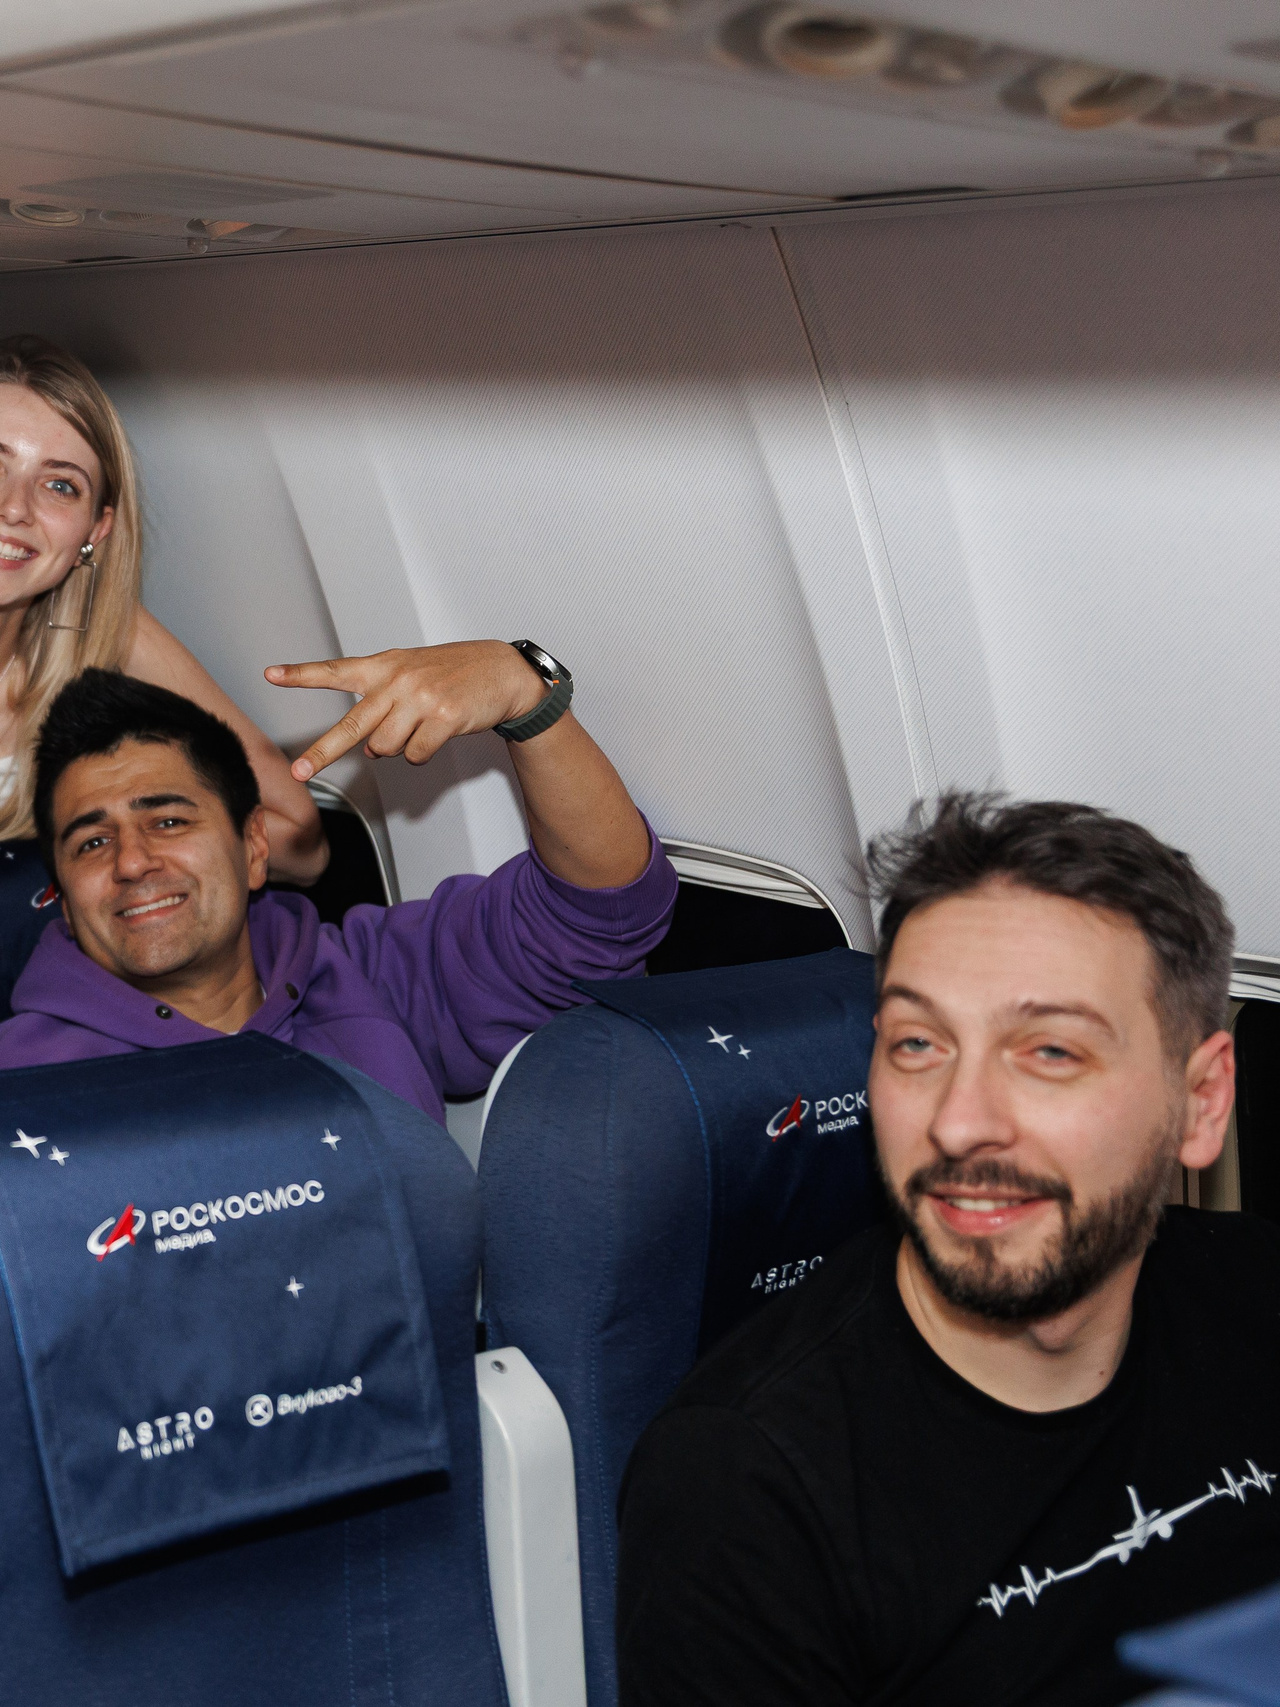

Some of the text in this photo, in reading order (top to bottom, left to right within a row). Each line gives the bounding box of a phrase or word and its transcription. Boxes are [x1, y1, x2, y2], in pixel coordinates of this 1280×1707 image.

[817, 1115, 860, 1135] медиа
[151, 1179, 325, 1236] РОСКОСМОС
[116, 1406, 215, 1454] ASTRO
[139, 1432, 196, 1461] NIGHT
